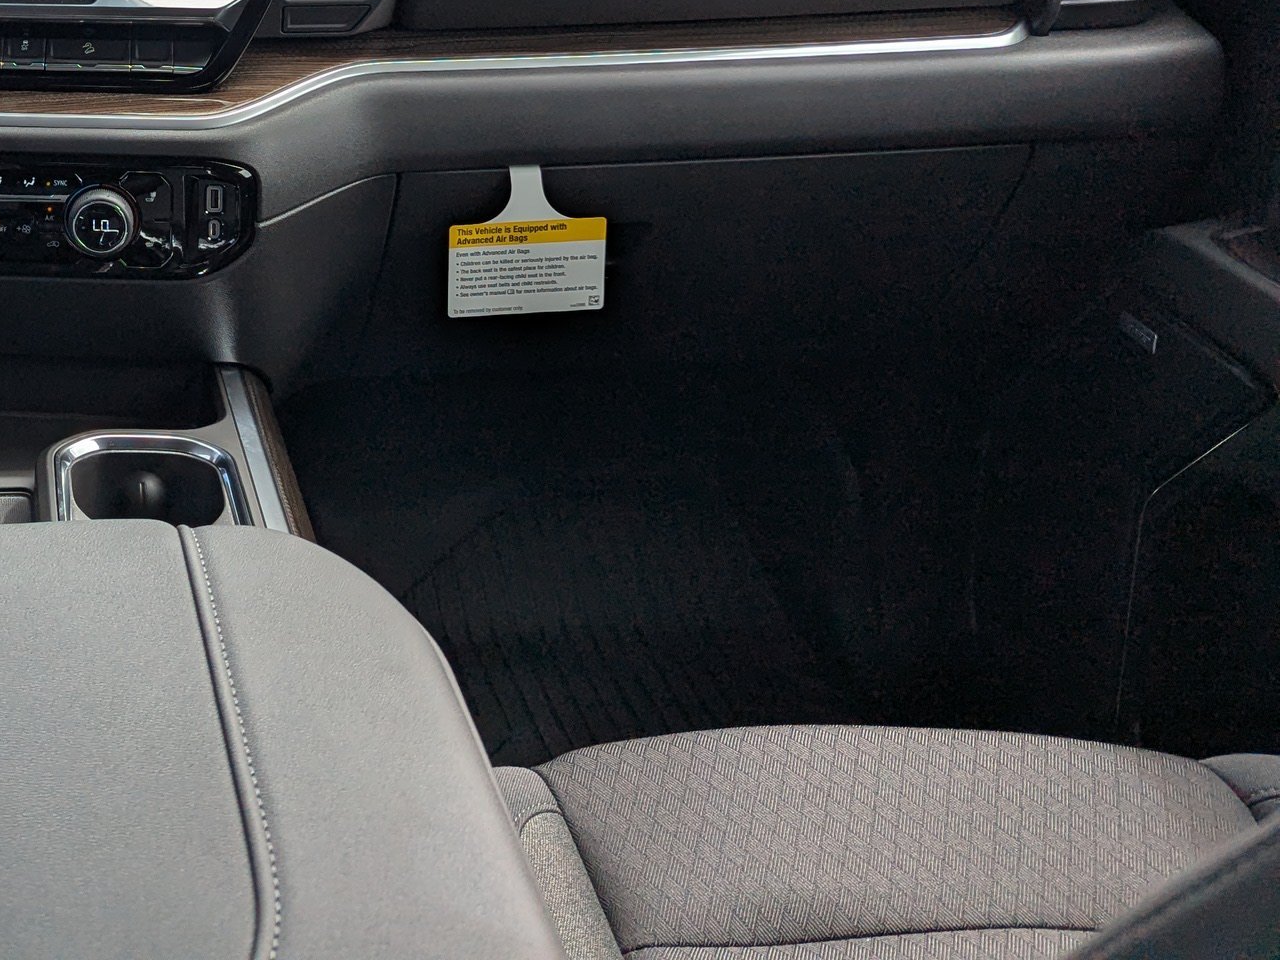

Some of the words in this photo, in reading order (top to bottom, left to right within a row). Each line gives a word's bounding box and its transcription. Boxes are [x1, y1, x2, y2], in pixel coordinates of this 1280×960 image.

[474, 226, 502, 235] Vehicle
[513, 224, 548, 234] Equipped
[550, 223, 567, 231] with
[456, 236, 494, 245] Advanced
[496, 235, 507, 243] Air
[509, 234, 529, 244] Bags
